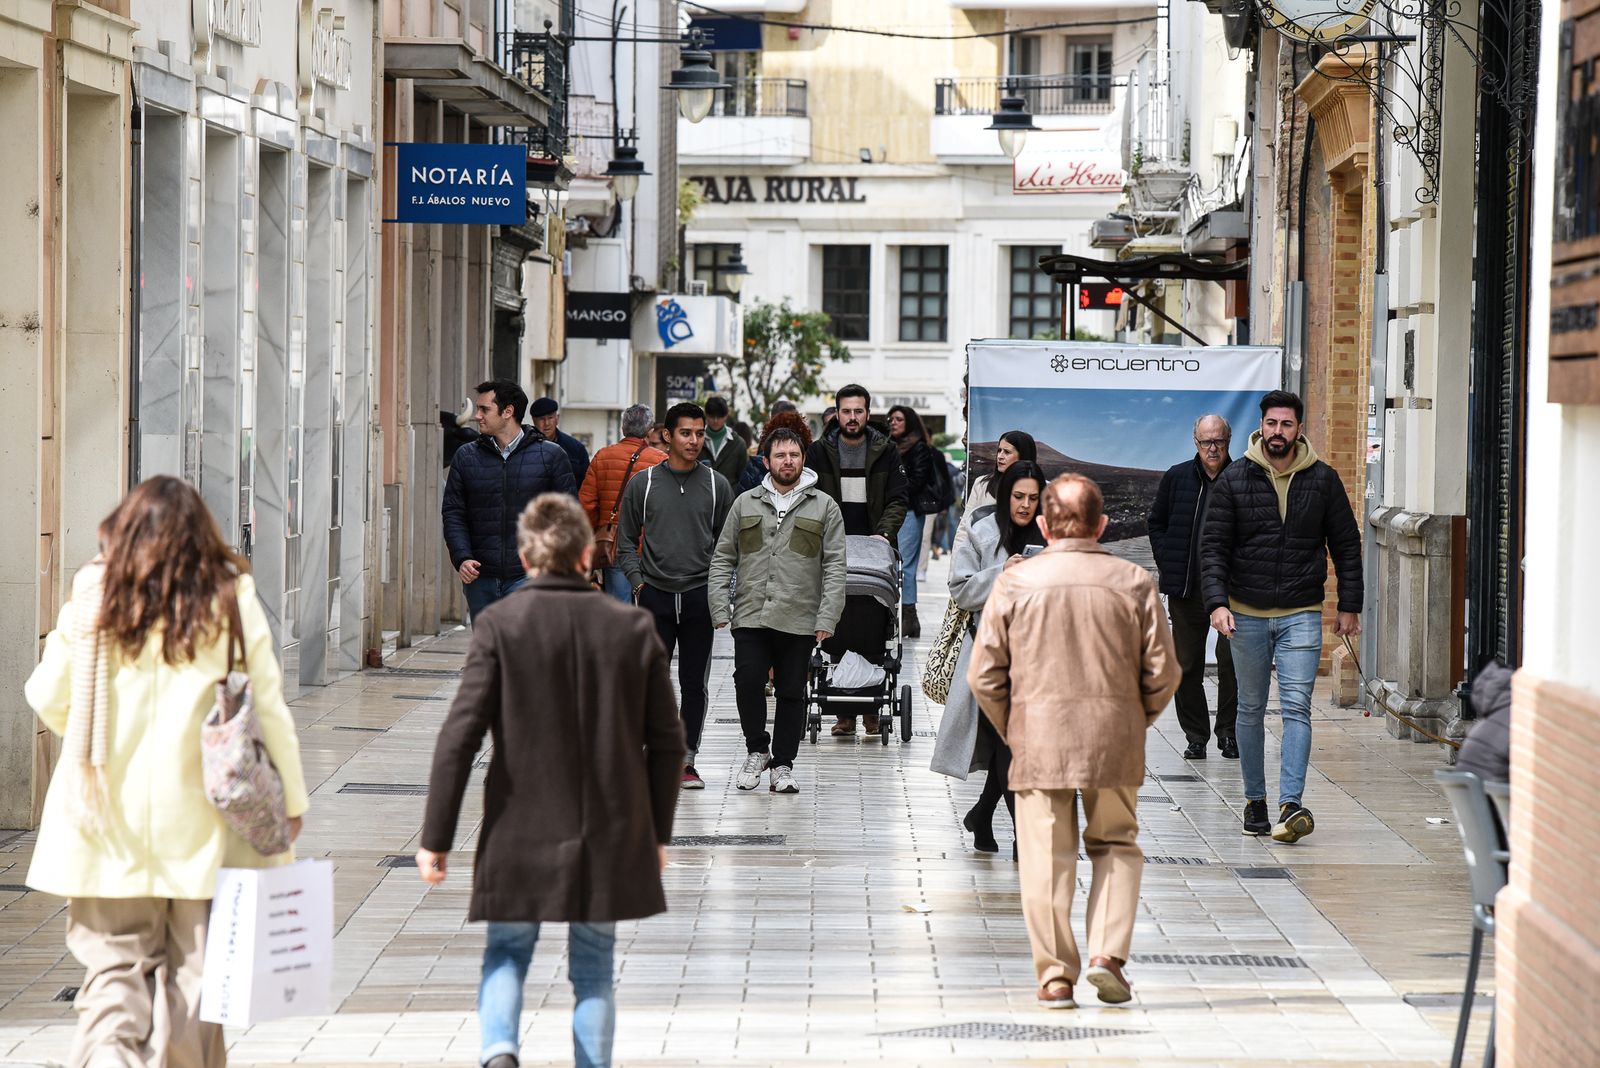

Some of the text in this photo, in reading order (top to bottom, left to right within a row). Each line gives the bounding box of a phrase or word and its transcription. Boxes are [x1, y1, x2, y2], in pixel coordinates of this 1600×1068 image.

[411, 164, 514, 186] NOTARÍA
[764, 176, 866, 202] RURAL
[427, 194, 466, 205] ÁBALOS
[471, 196, 511, 206] NUEVO
[567, 309, 627, 322] MANGO
[1072, 357, 1200, 372] encuentro
